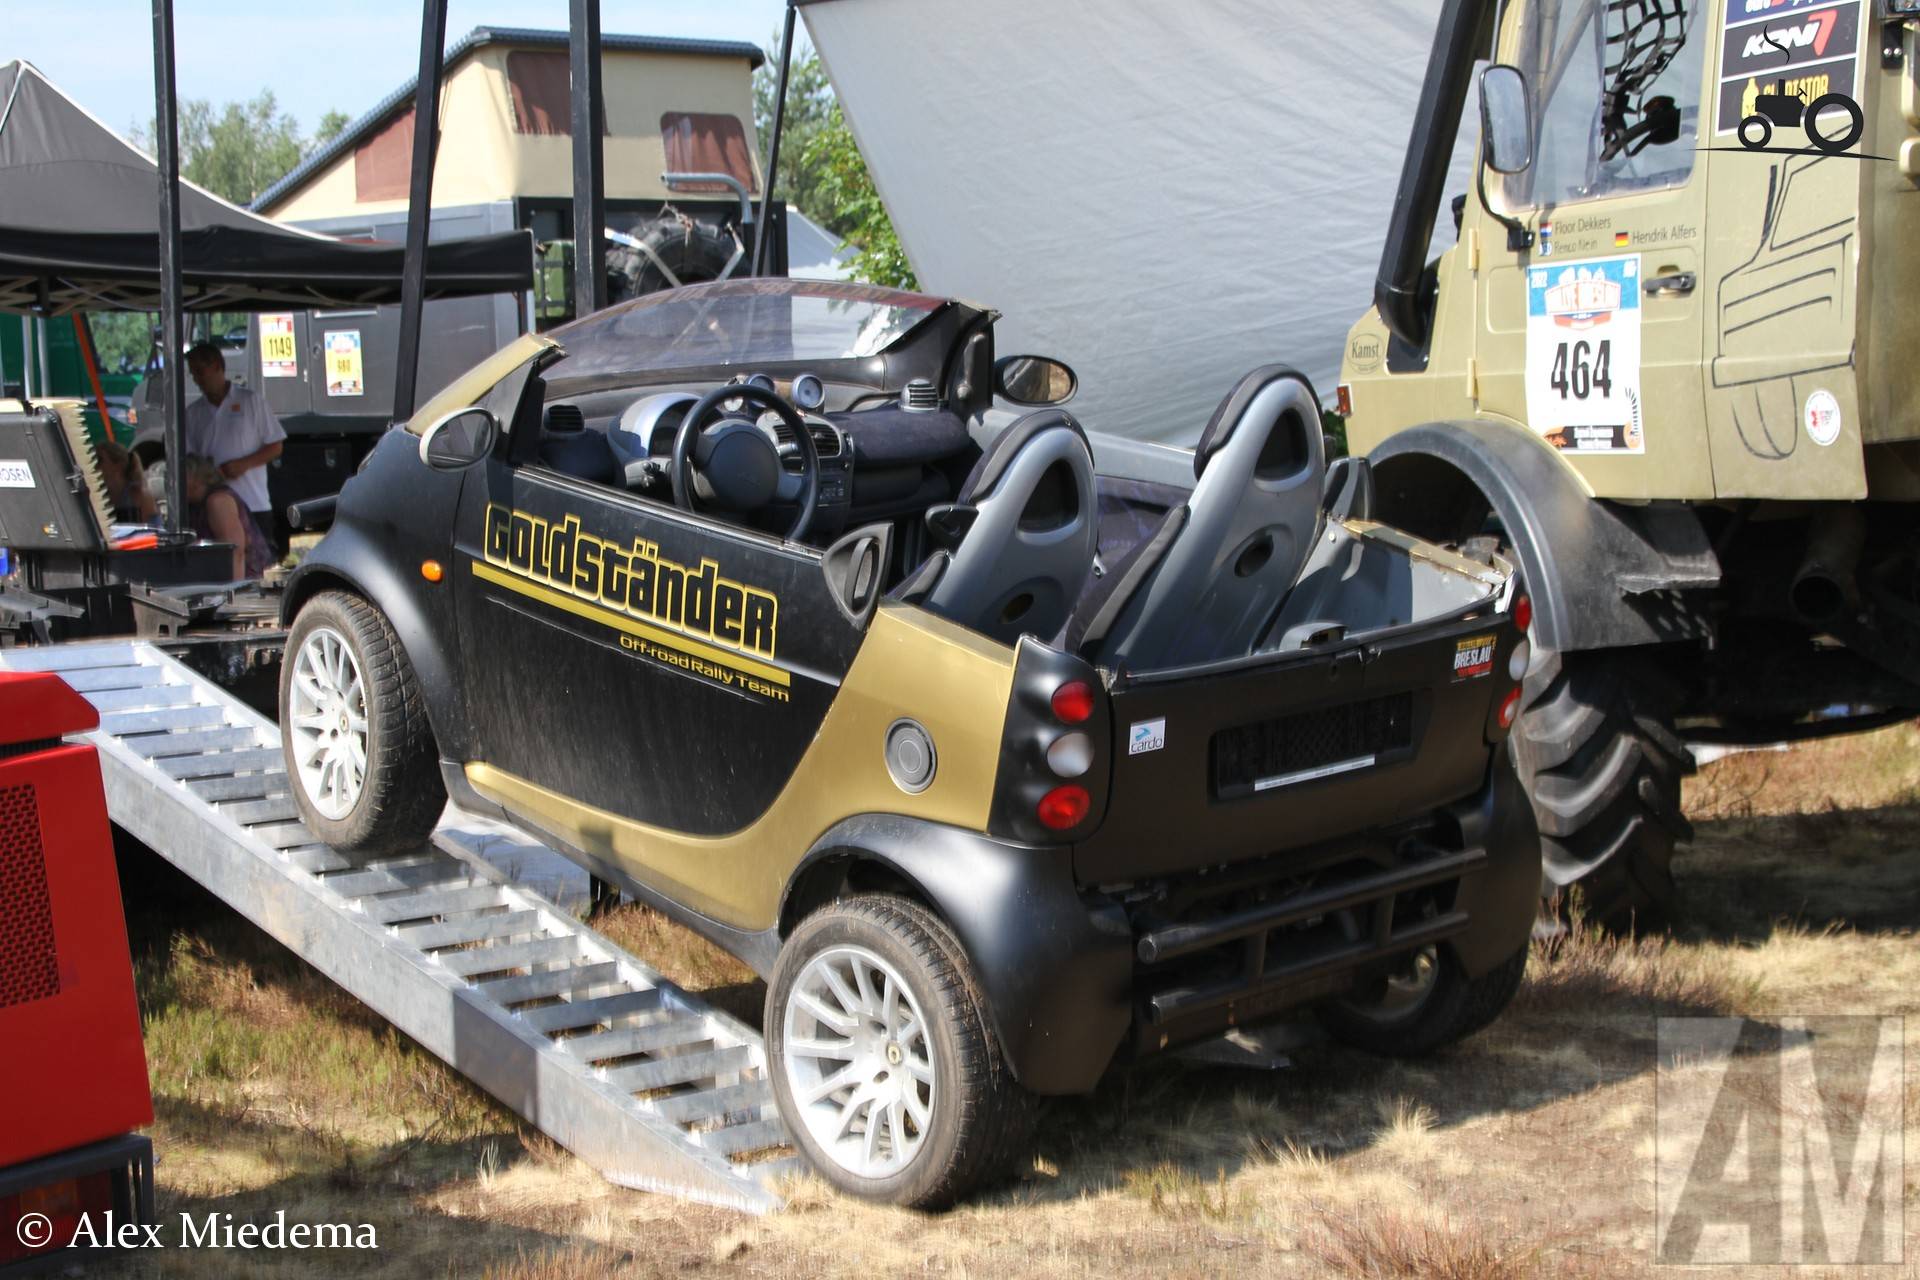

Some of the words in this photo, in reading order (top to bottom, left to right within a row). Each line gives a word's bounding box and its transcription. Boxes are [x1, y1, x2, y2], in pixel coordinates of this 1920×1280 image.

[1578, 216, 1612, 232] Dekkers
[1633, 227, 1668, 245] Hendrik
[1671, 225, 1697, 241] Alfers
[268, 336, 293, 358] 1149
[1352, 341, 1379, 359] Kamst
[1550, 339, 1612, 400] 464
[619, 631, 690, 670] Off-road
[691, 660, 734, 685] Rally
[735, 674, 790, 703] Team
[1454, 645, 1492, 670] BRESLAU
[1131, 736, 1164, 753] cardo
